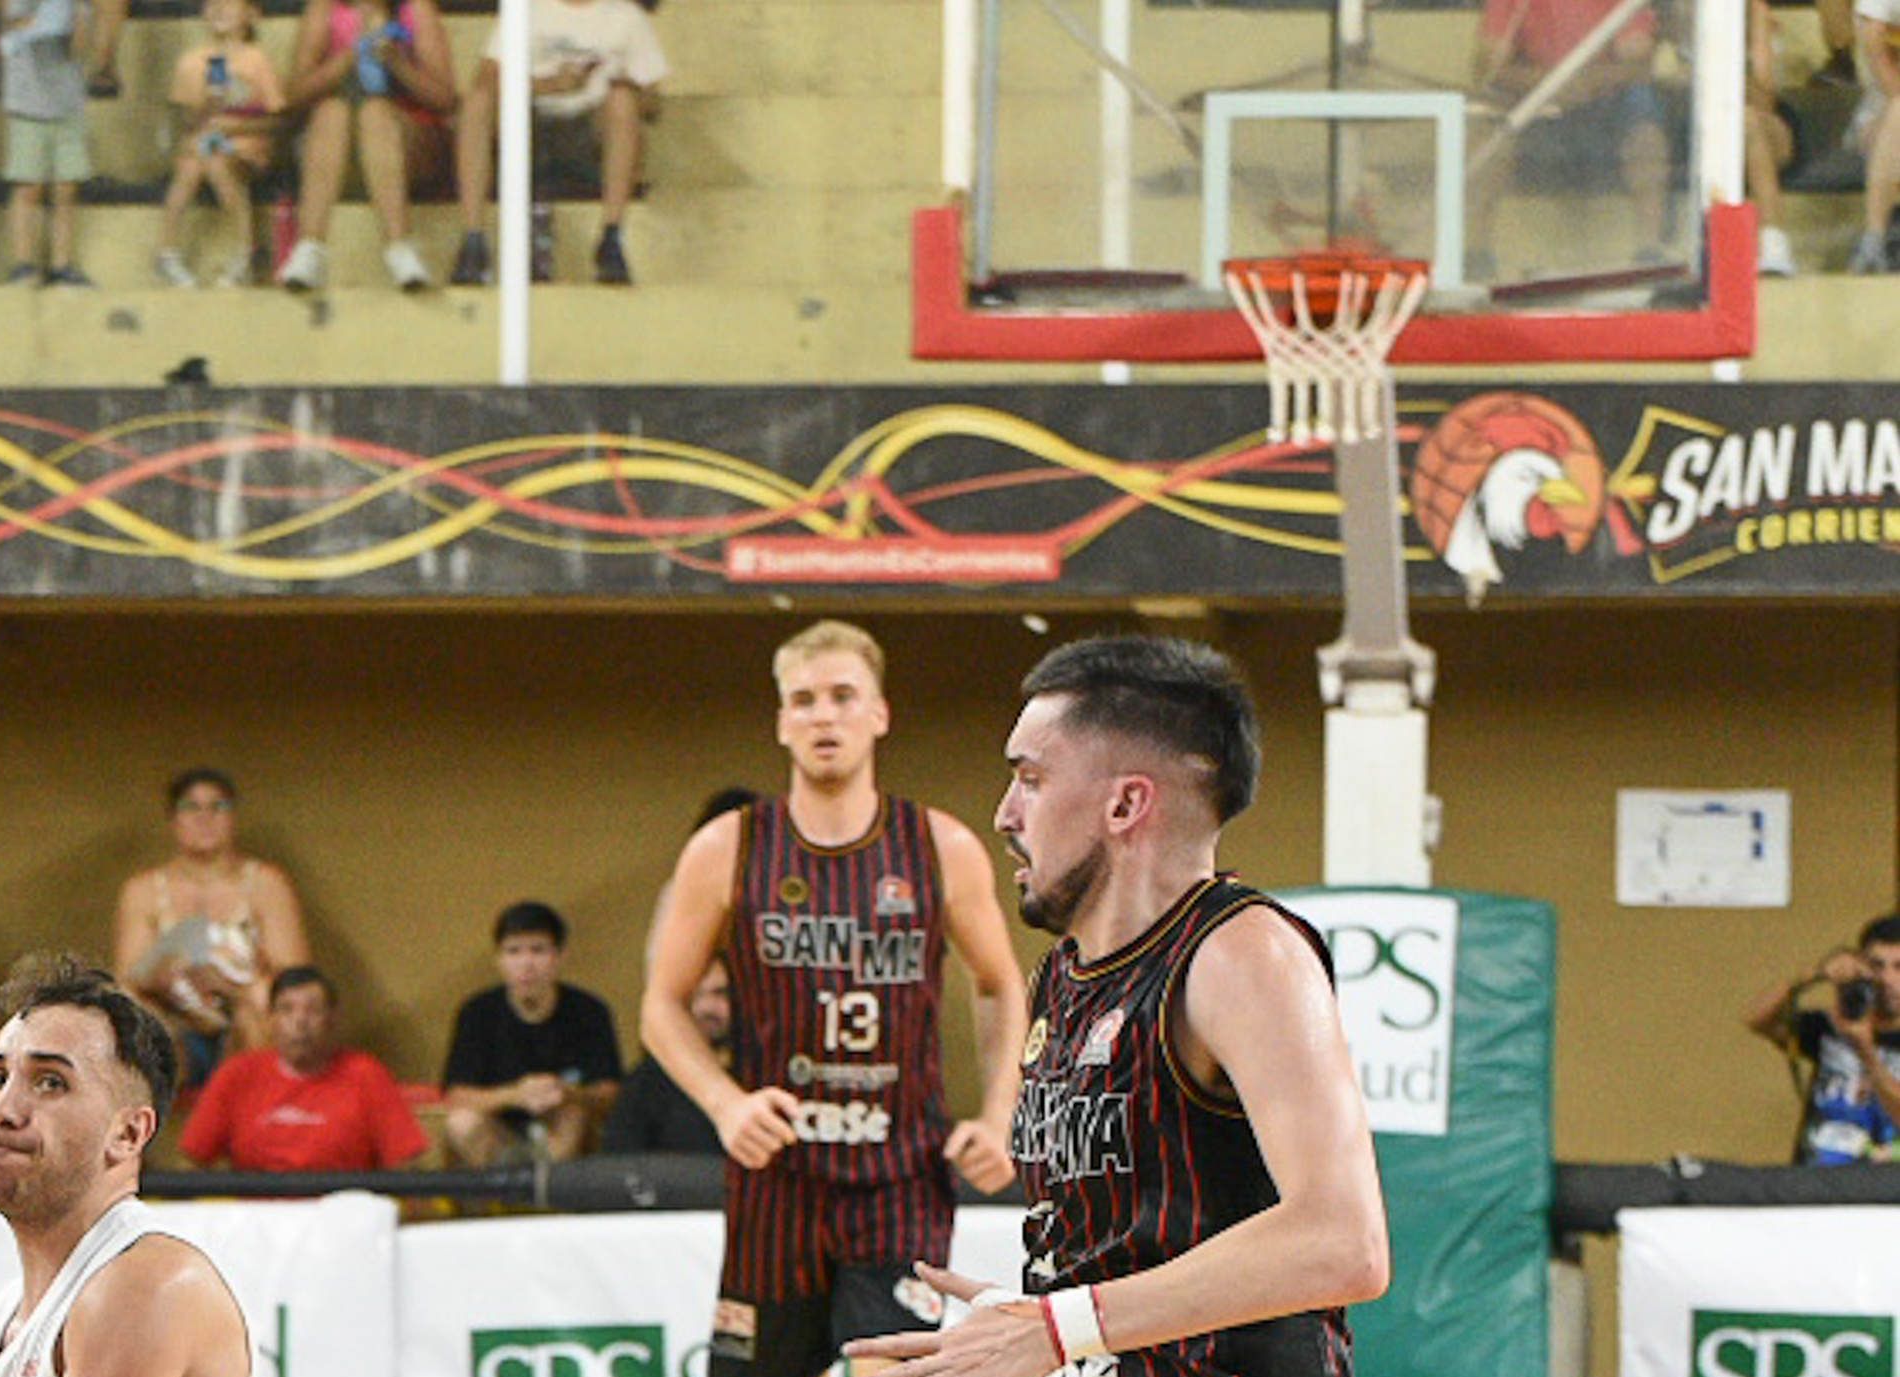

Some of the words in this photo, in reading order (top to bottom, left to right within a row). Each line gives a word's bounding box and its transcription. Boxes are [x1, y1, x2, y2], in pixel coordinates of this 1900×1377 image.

[1647, 425, 1797, 545] SAN
[755, 910, 857, 971] SAN
[1326, 924, 1441, 1031] PS
[817, 991, 880, 1052] 13
